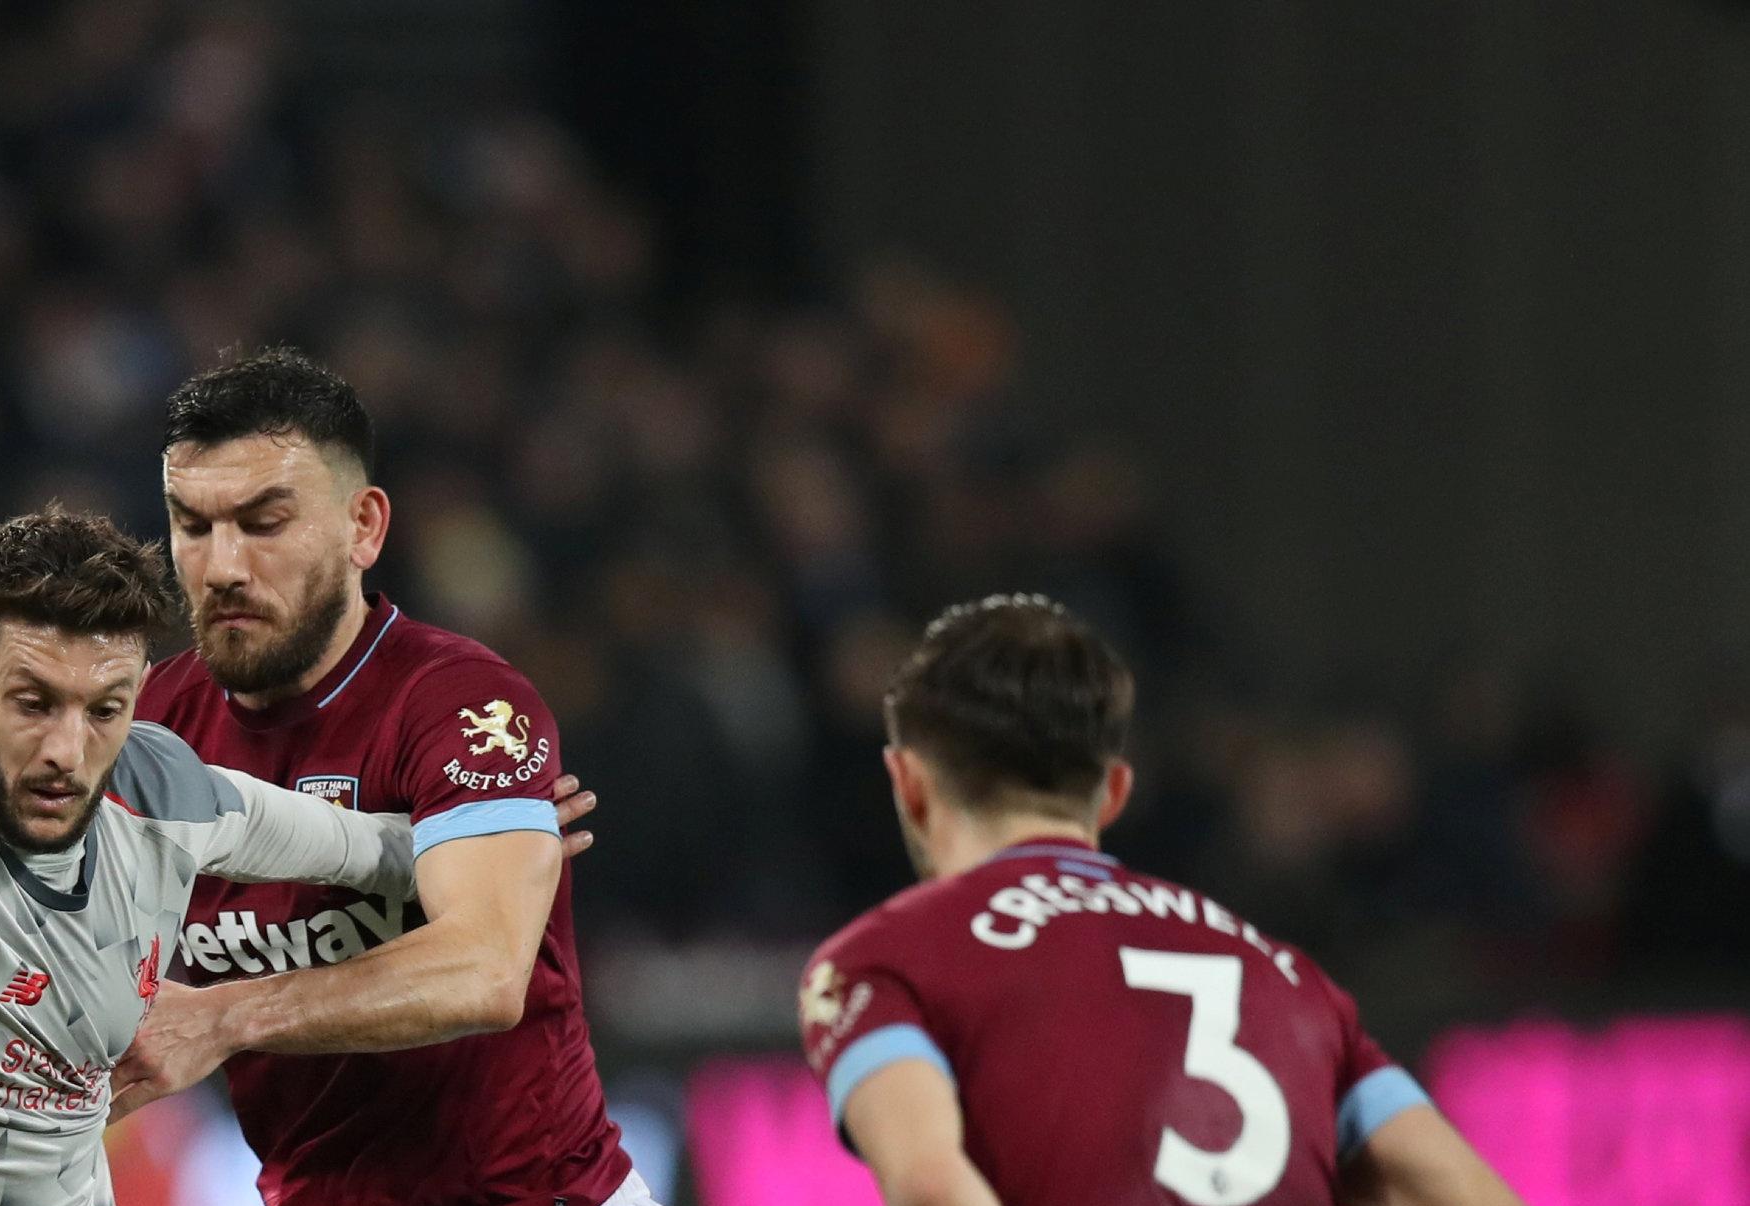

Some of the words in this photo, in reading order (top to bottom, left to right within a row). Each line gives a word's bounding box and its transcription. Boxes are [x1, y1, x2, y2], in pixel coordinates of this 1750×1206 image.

[515, 737, 550, 782] GOLD
[302, 782, 329, 792] WEST
[329, 781, 352, 791] HAM
